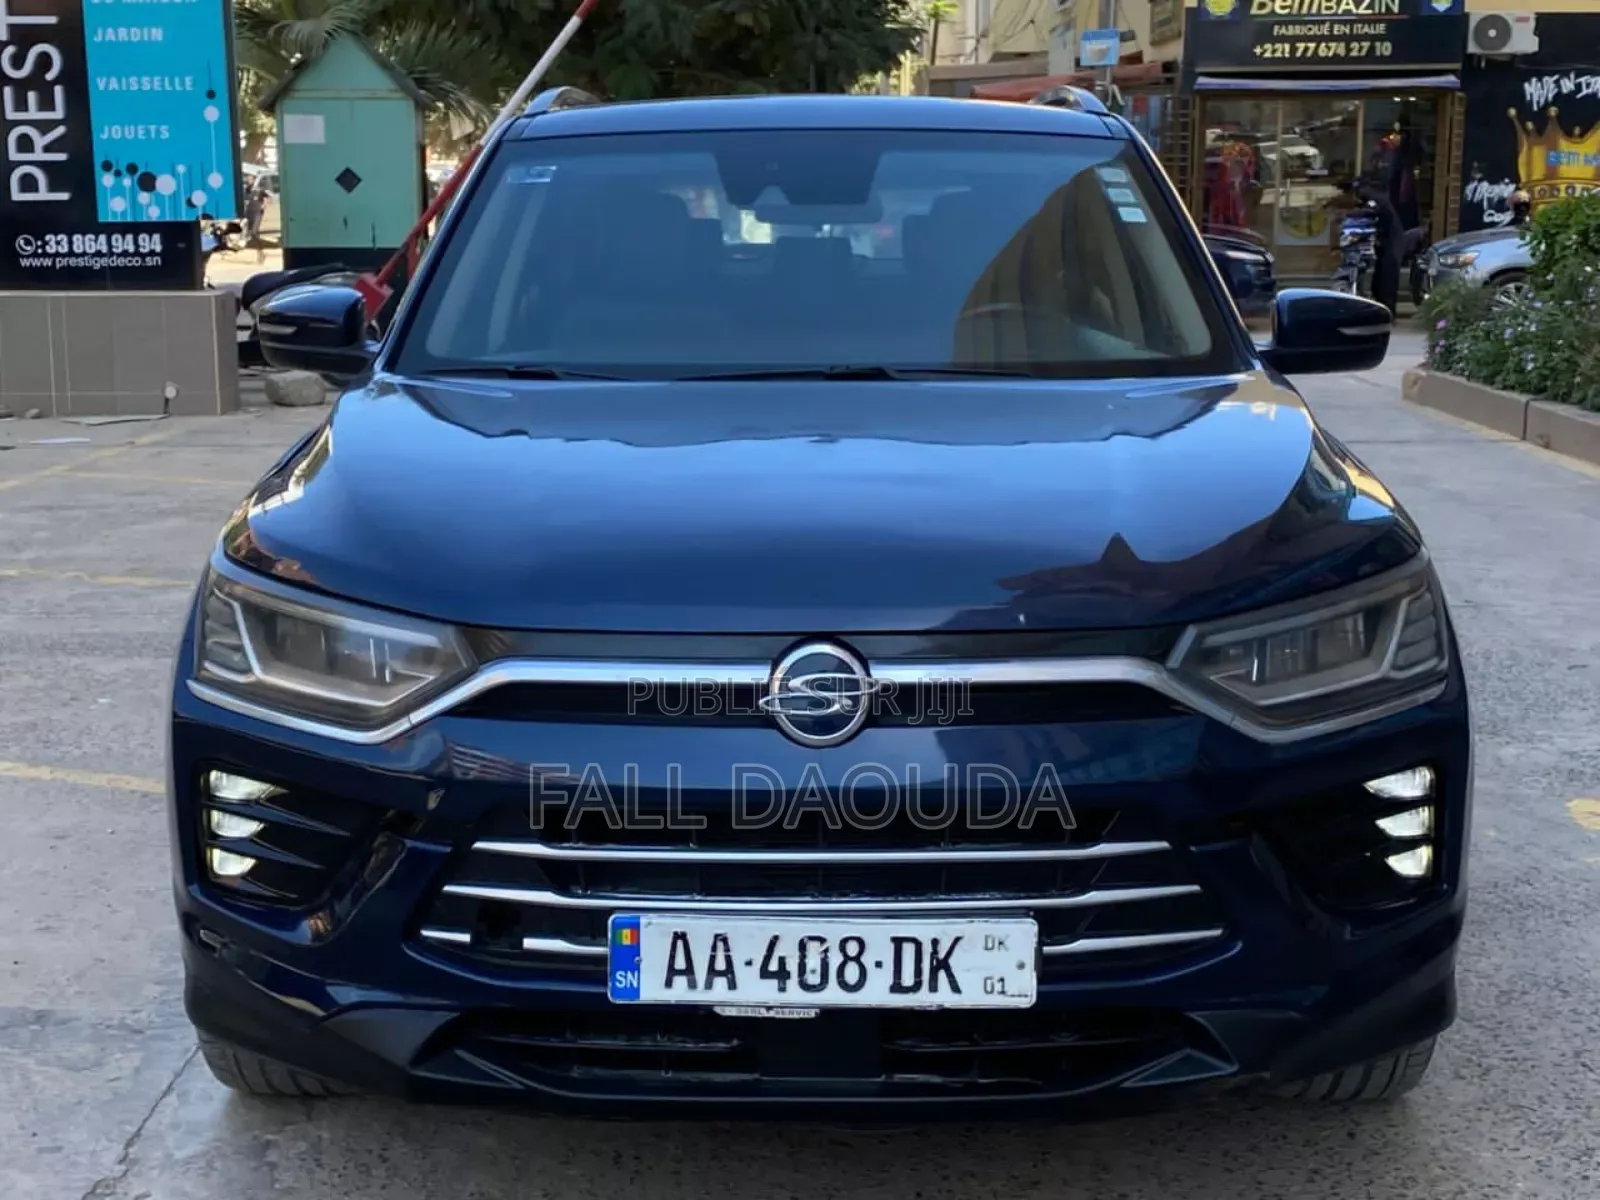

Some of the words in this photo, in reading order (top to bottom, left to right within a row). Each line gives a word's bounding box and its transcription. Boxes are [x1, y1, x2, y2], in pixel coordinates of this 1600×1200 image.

[93, 27, 163, 42] JARDIN
[1273, 22, 1330, 36] FABRIQUÉ
[1333, 24, 1350, 35] EN
[1353, 23, 1387, 34] ITALIE
[1253, 43, 1290, 58] +221
[1295, 42, 1317, 57] 77
[1318, 42, 1346, 57] 674
[1350, 42, 1370, 56] 27
[1375, 41, 1392, 56] 10
[96, 76, 194, 91] VAISSELLE
[100, 125, 170, 140] JOUETS
[72, 234, 109, 253] 864
[111, 233, 135, 253] 94
[138, 233, 162, 253] 94
[983, 933, 1010, 953] DK
[615, 970, 639, 989] SN
[983, 975, 1007, 996] 01
